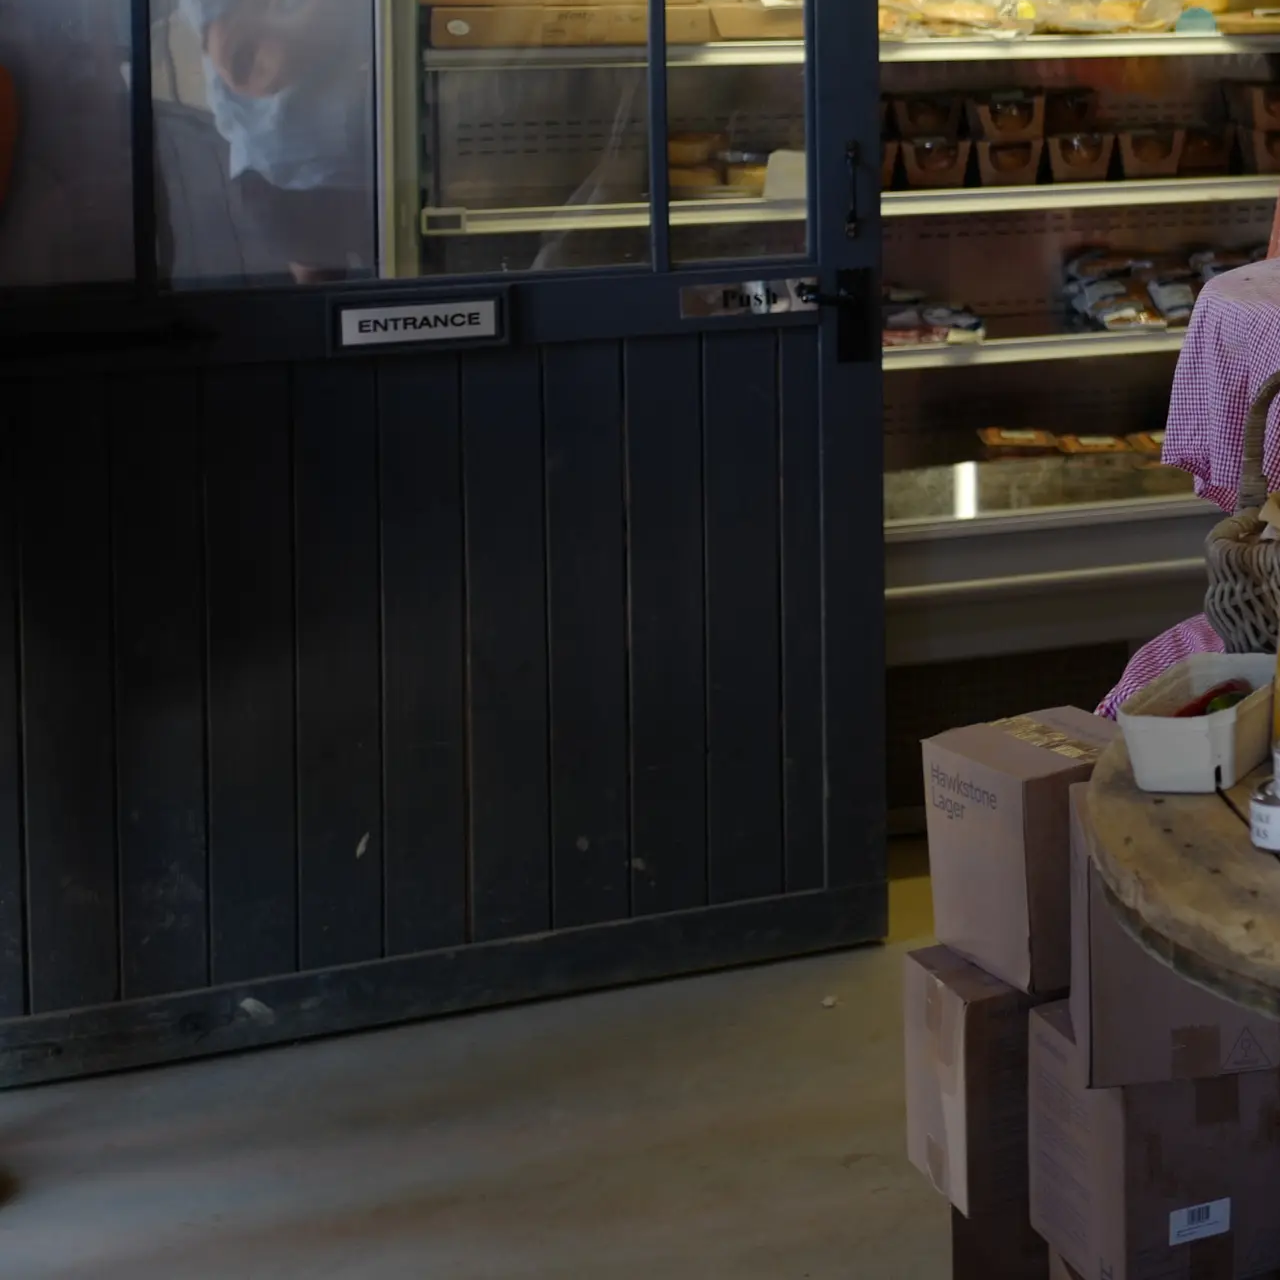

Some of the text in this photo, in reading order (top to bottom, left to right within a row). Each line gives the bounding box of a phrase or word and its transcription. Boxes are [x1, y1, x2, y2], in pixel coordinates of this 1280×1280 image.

[722, 287, 778, 309] Push
[358, 312, 481, 334] ENTRANCE
[930, 761, 998, 811] Hawkstone
[932, 785, 967, 820] Lager
